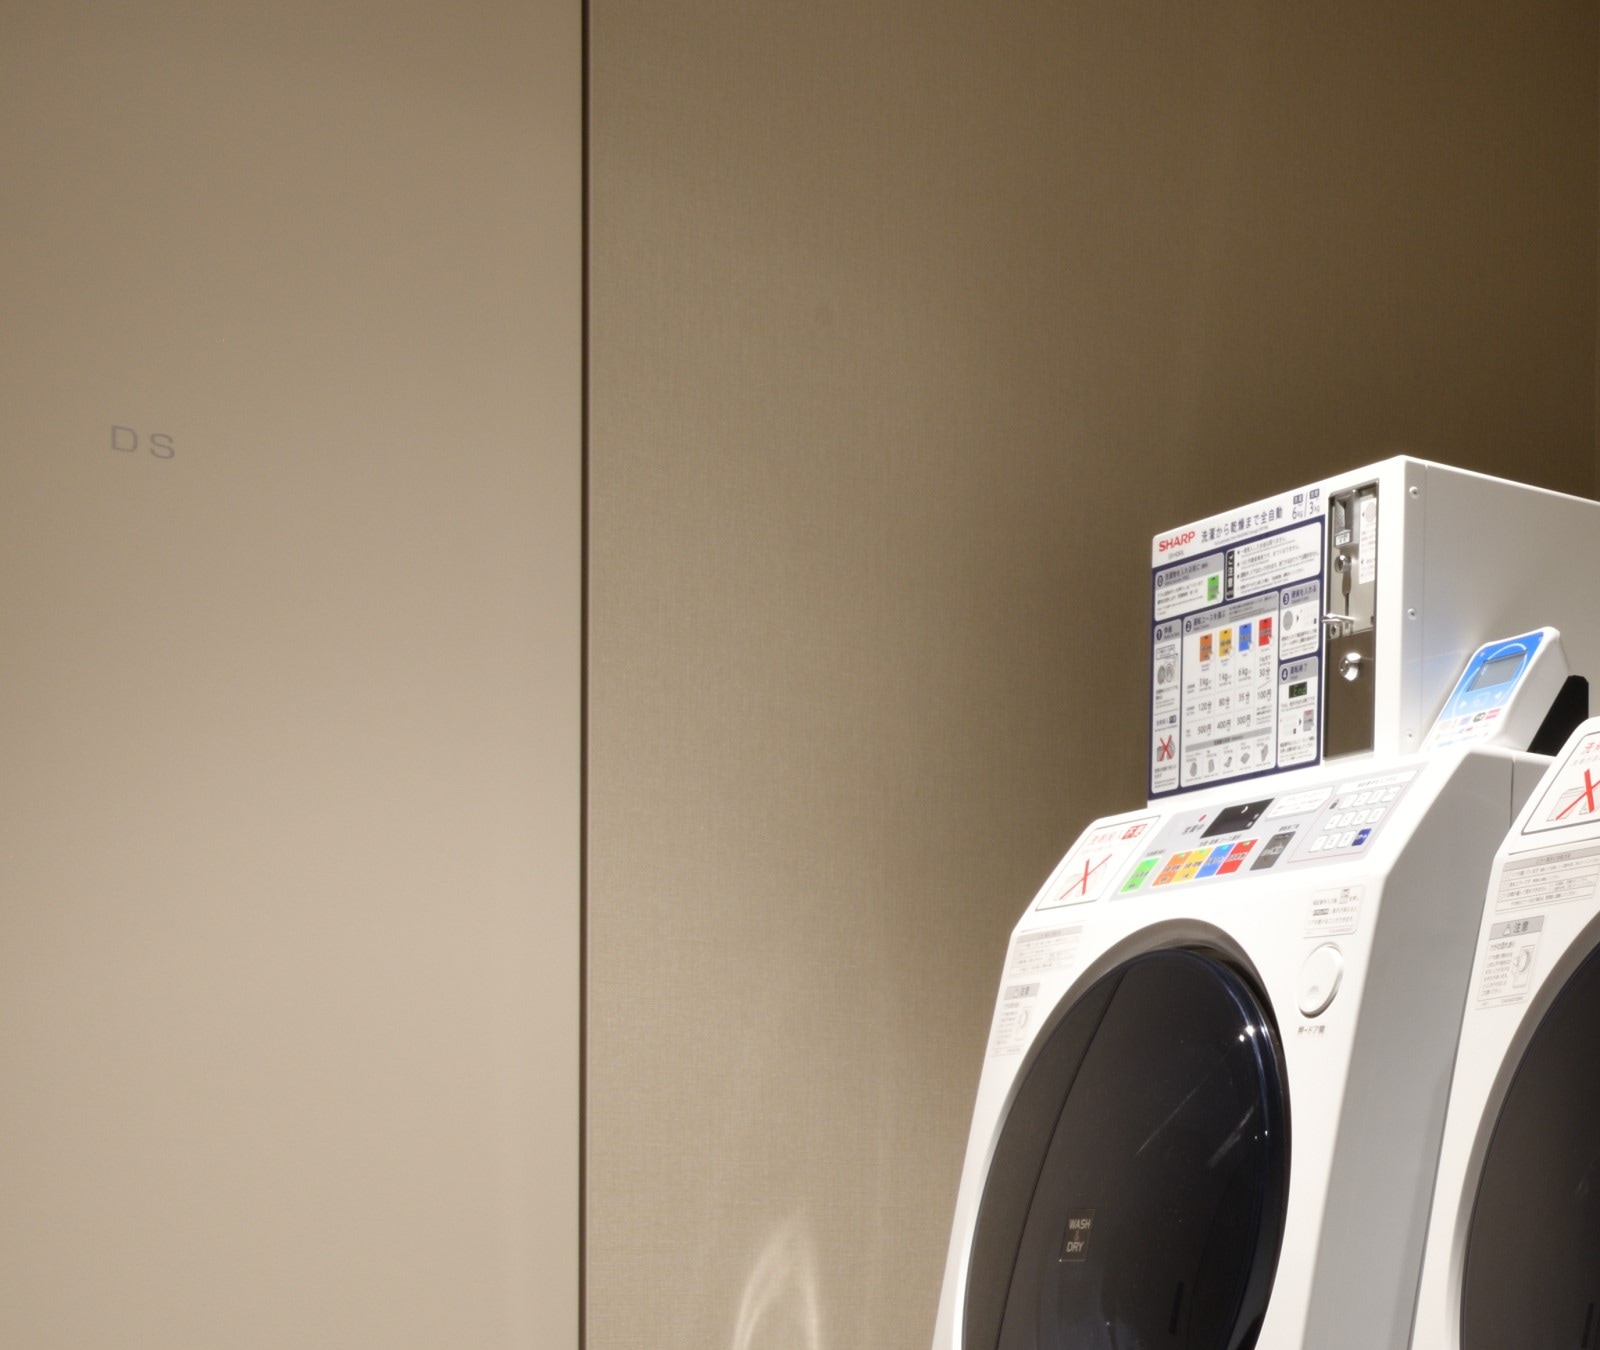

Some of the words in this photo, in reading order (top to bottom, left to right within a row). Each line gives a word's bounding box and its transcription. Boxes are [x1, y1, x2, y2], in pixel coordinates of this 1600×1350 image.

[1201, 507, 1284, 543] 洗濯から乾燥まで全自動
[1158, 531, 1196, 552] SHARP
[1070, 1219, 1091, 1230] WASH
[1066, 1242, 1084, 1252] DRY
